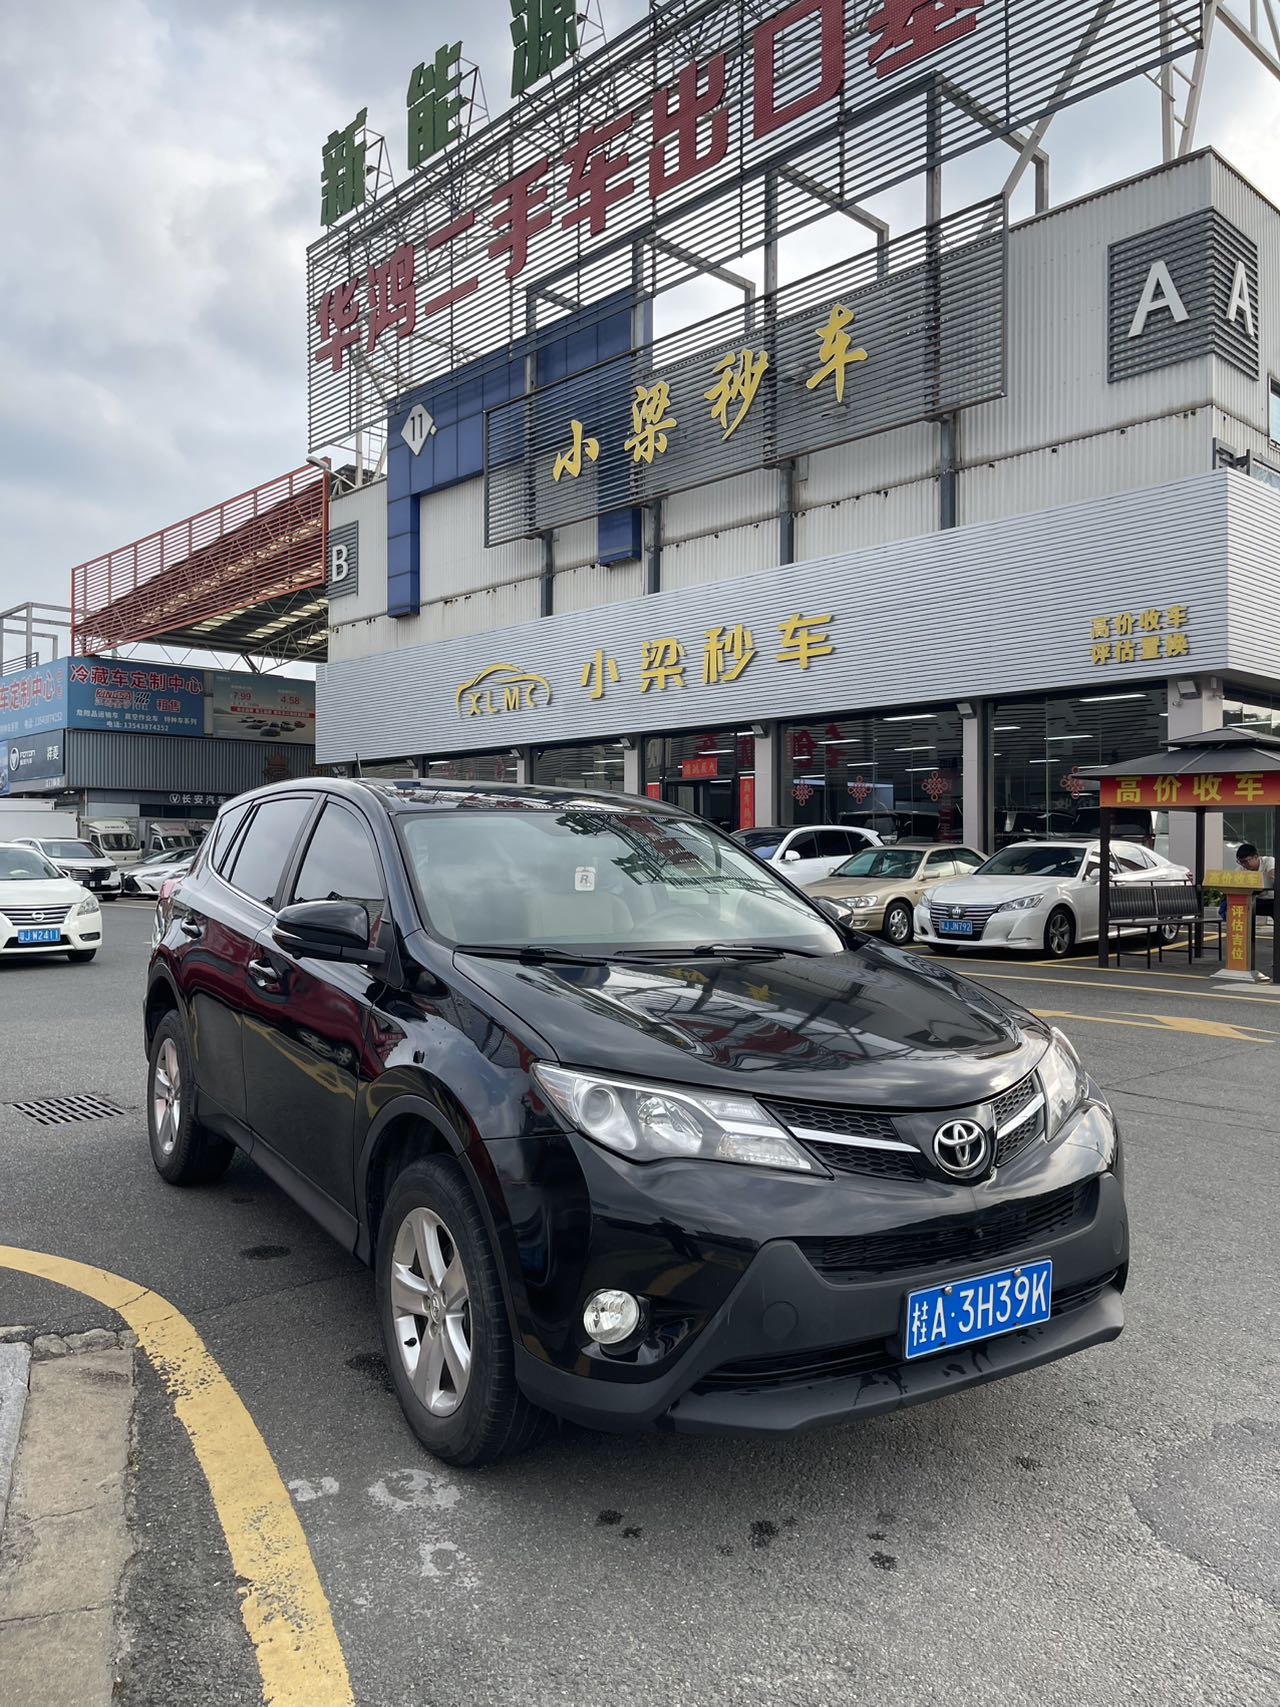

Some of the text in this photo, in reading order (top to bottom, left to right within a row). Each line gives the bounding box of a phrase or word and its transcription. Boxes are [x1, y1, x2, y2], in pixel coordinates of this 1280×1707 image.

[1128, 259, 1190, 338] A
[1226, 260, 1255, 338] A
[552, 302, 868, 481] 小梁秒车
[409, 412, 424, 442] 11
[331, 544, 349, 583] B
[1090, 605, 1188, 639] 高价收车
[580, 612, 835, 700] 小梁秒车
[1090, 633, 1189, 665] 评估置换
[70, 664, 203, 694] 冷藏车定制中心
[1115, 772, 1265, 804] 高价收车
